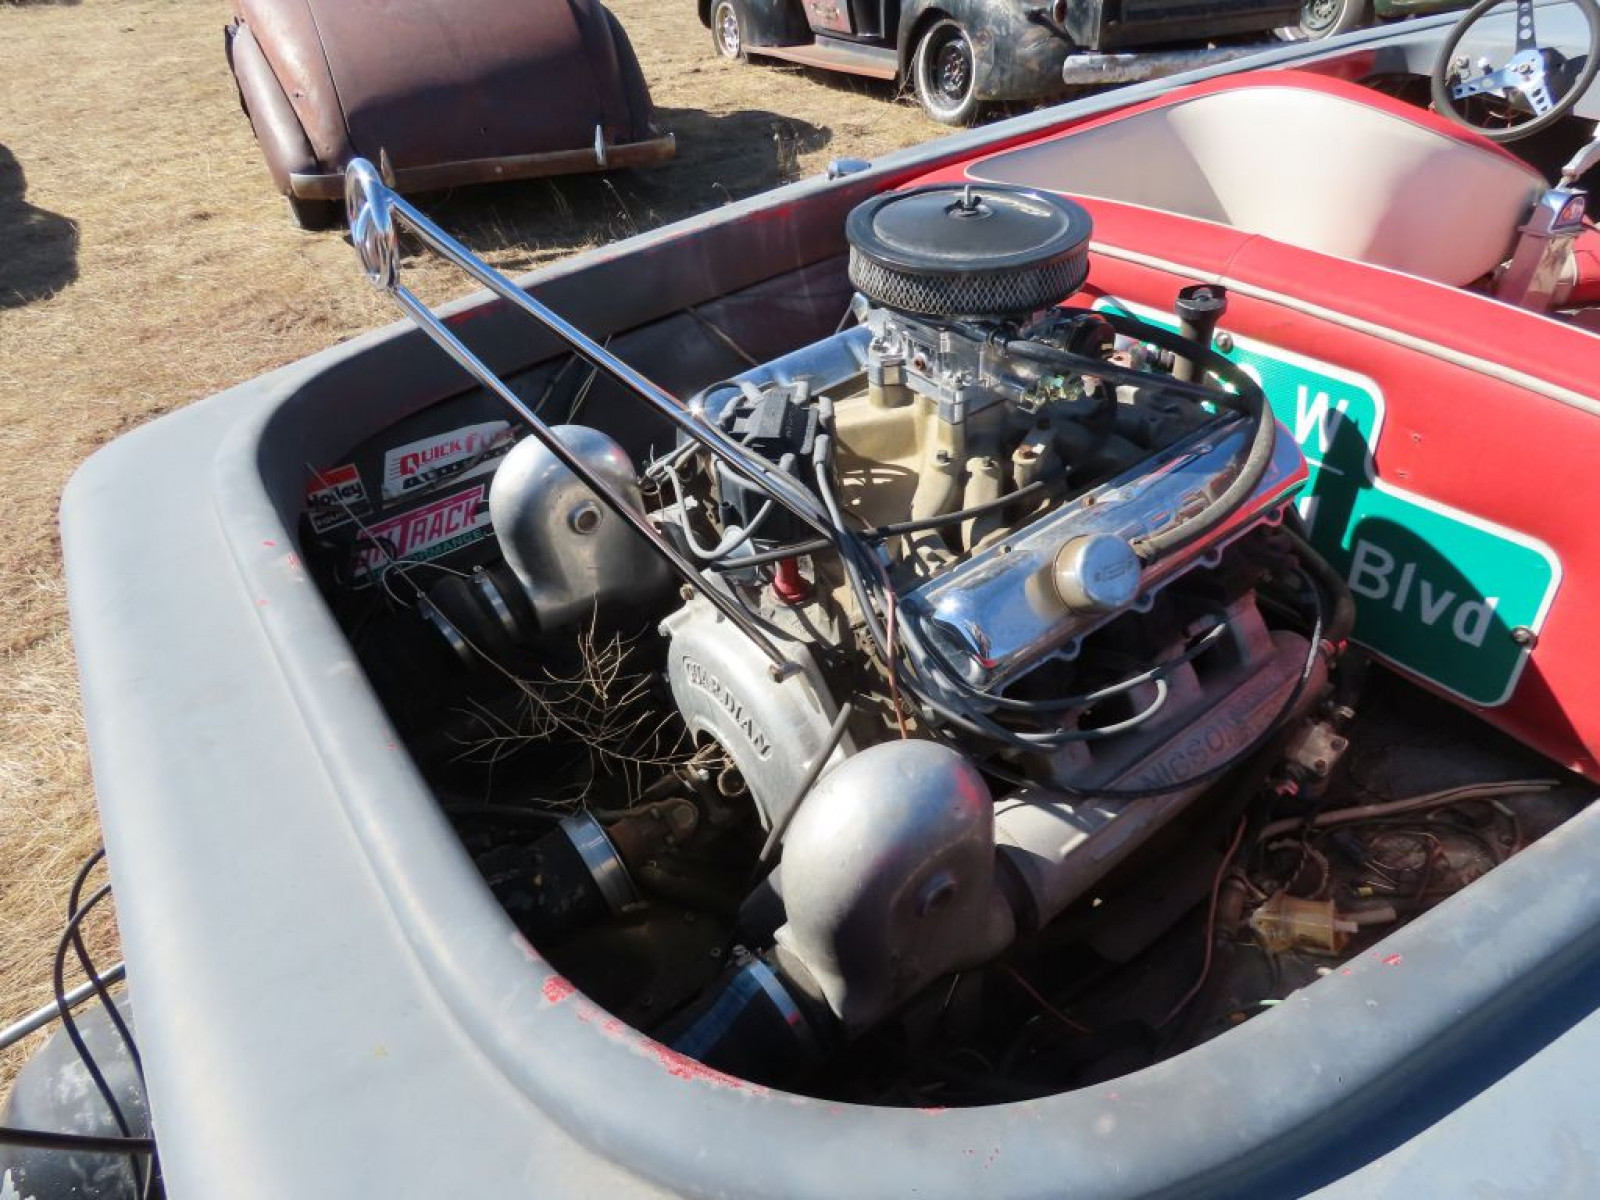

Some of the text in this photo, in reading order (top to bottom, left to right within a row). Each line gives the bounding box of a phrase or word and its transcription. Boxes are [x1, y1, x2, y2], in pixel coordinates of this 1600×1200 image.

[1294, 384, 1348, 453] W
[400, 440, 461, 476] QUICK
[1349, 538, 1500, 648] Blvd
